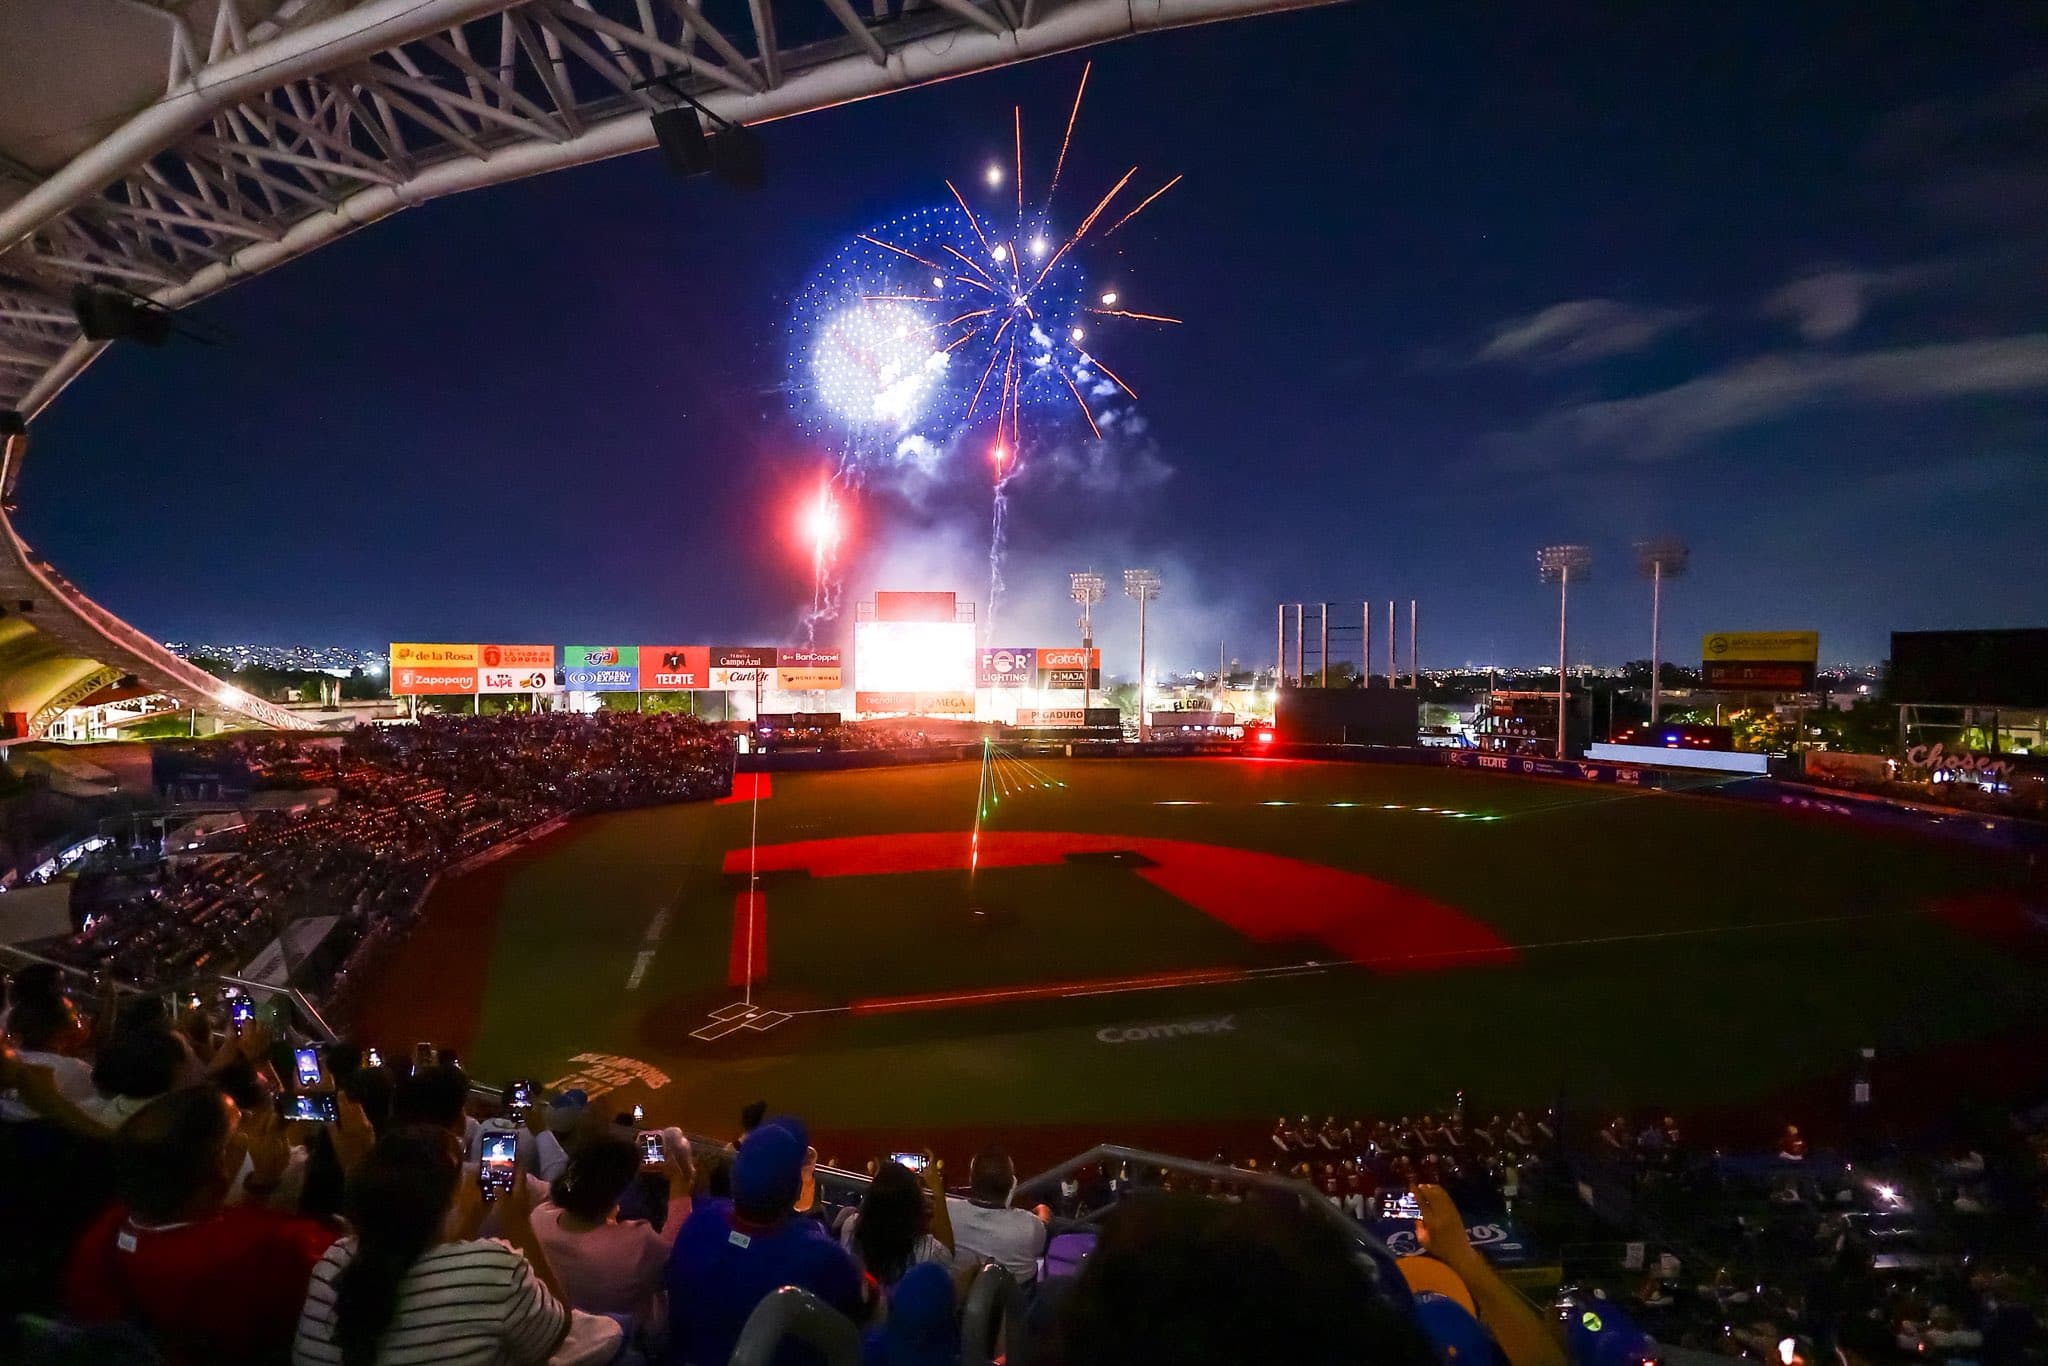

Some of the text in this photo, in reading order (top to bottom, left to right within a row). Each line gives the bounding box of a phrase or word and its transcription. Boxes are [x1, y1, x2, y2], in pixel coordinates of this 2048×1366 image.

[416, 651, 473, 661] de la Rosa
[584, 652, 611, 665] aga
[795, 652, 839, 663] BanCoppel
[720, 657, 761, 667] Campo Azul
[655, 673, 694, 685] TECATE
[982, 673, 1027, 682] LIGHTING
[1061, 672, 1085, 681] MAJA
[1173, 700, 1184, 711] EL
[1031, 711, 1083, 719] PGADURO
[1477, 755, 1508, 769] TECATE
[1907, 743, 2015, 774] Chosen
